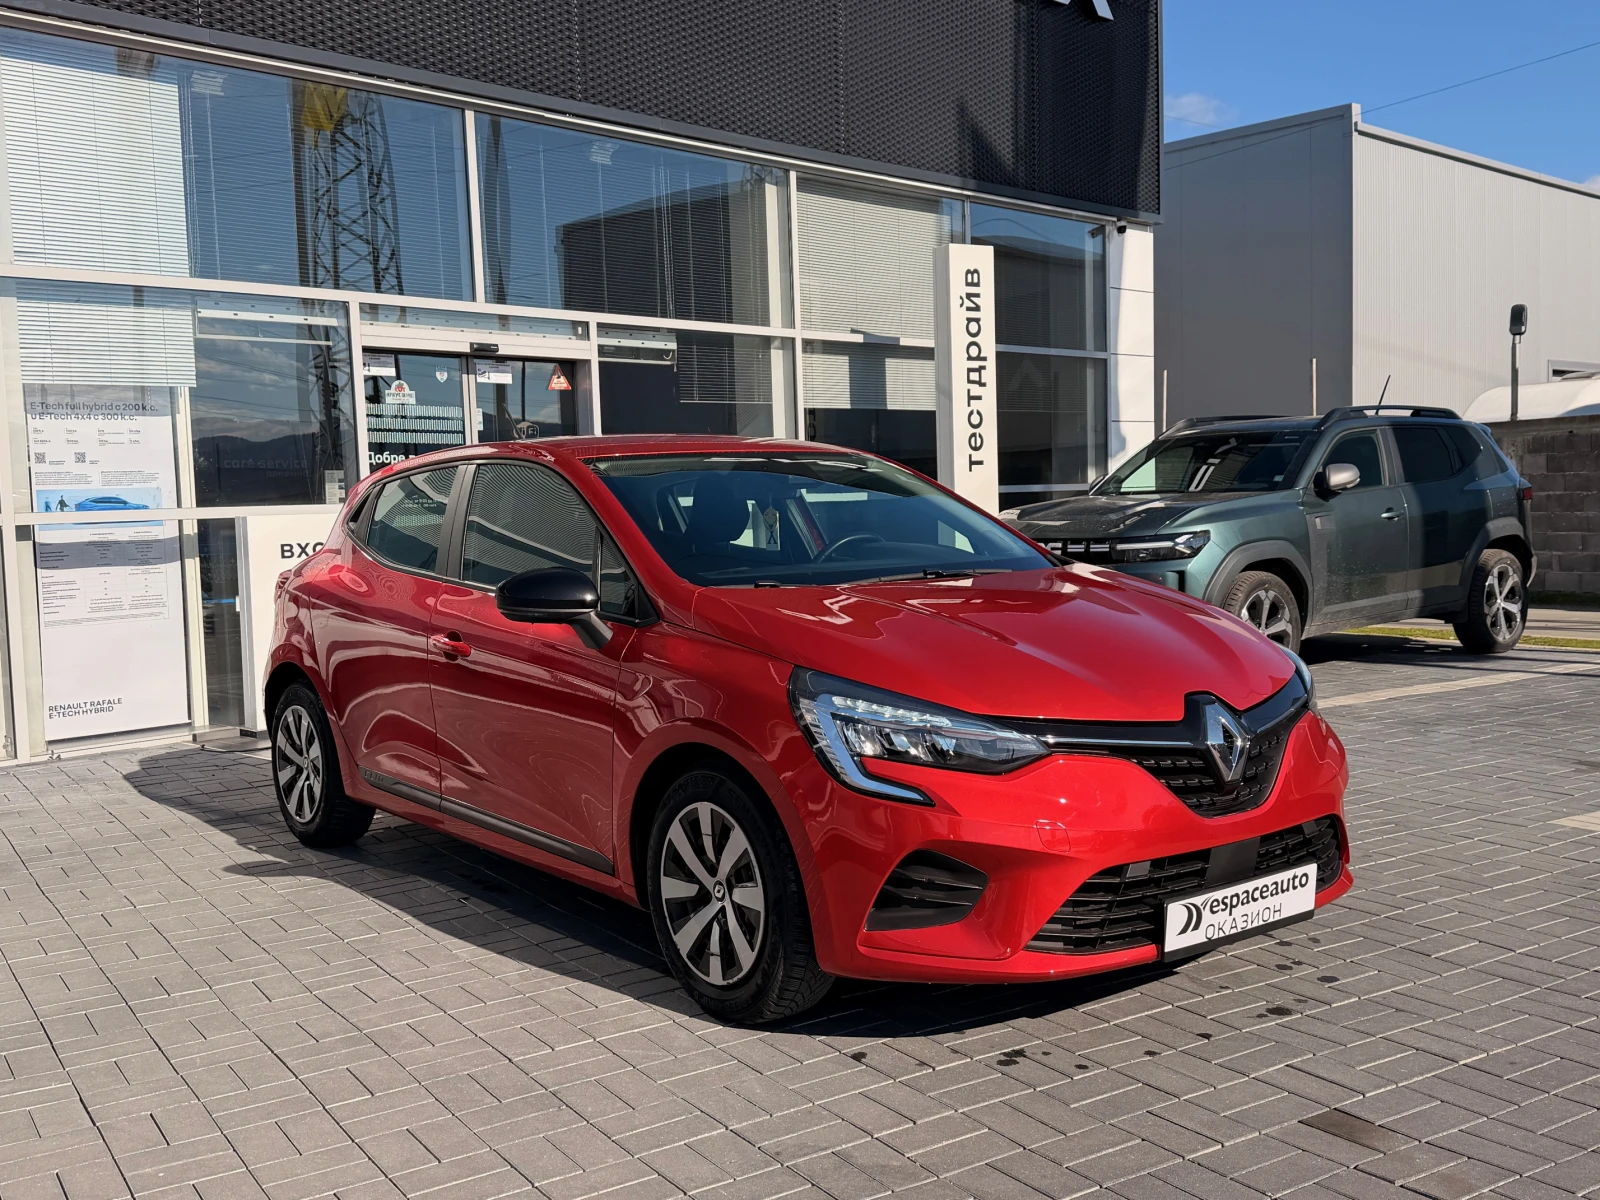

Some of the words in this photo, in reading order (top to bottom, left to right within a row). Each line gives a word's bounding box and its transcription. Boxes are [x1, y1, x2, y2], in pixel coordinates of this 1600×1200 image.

[959, 268, 988, 472] тестдрайв
[30, 402, 64, 410] E-Tech
[65, 402, 81, 410] full
[82, 402, 113, 412] hybrid
[123, 403, 140, 411] 200
[38, 412, 72, 420] E-Tech
[258, 457, 308, 468] service
[368, 451, 405, 466] Добре
[280, 542, 324, 559] ВХО
[49, 701, 89, 713] RENAULT
[90, 698, 122, 707] RAFALE
[49, 709, 81, 719] E-TECH
[82, 705, 114, 716] HYBRID
[1209, 871, 1309, 916] espaceauto
[1204, 902, 1282, 941] ОКАЗИОН
